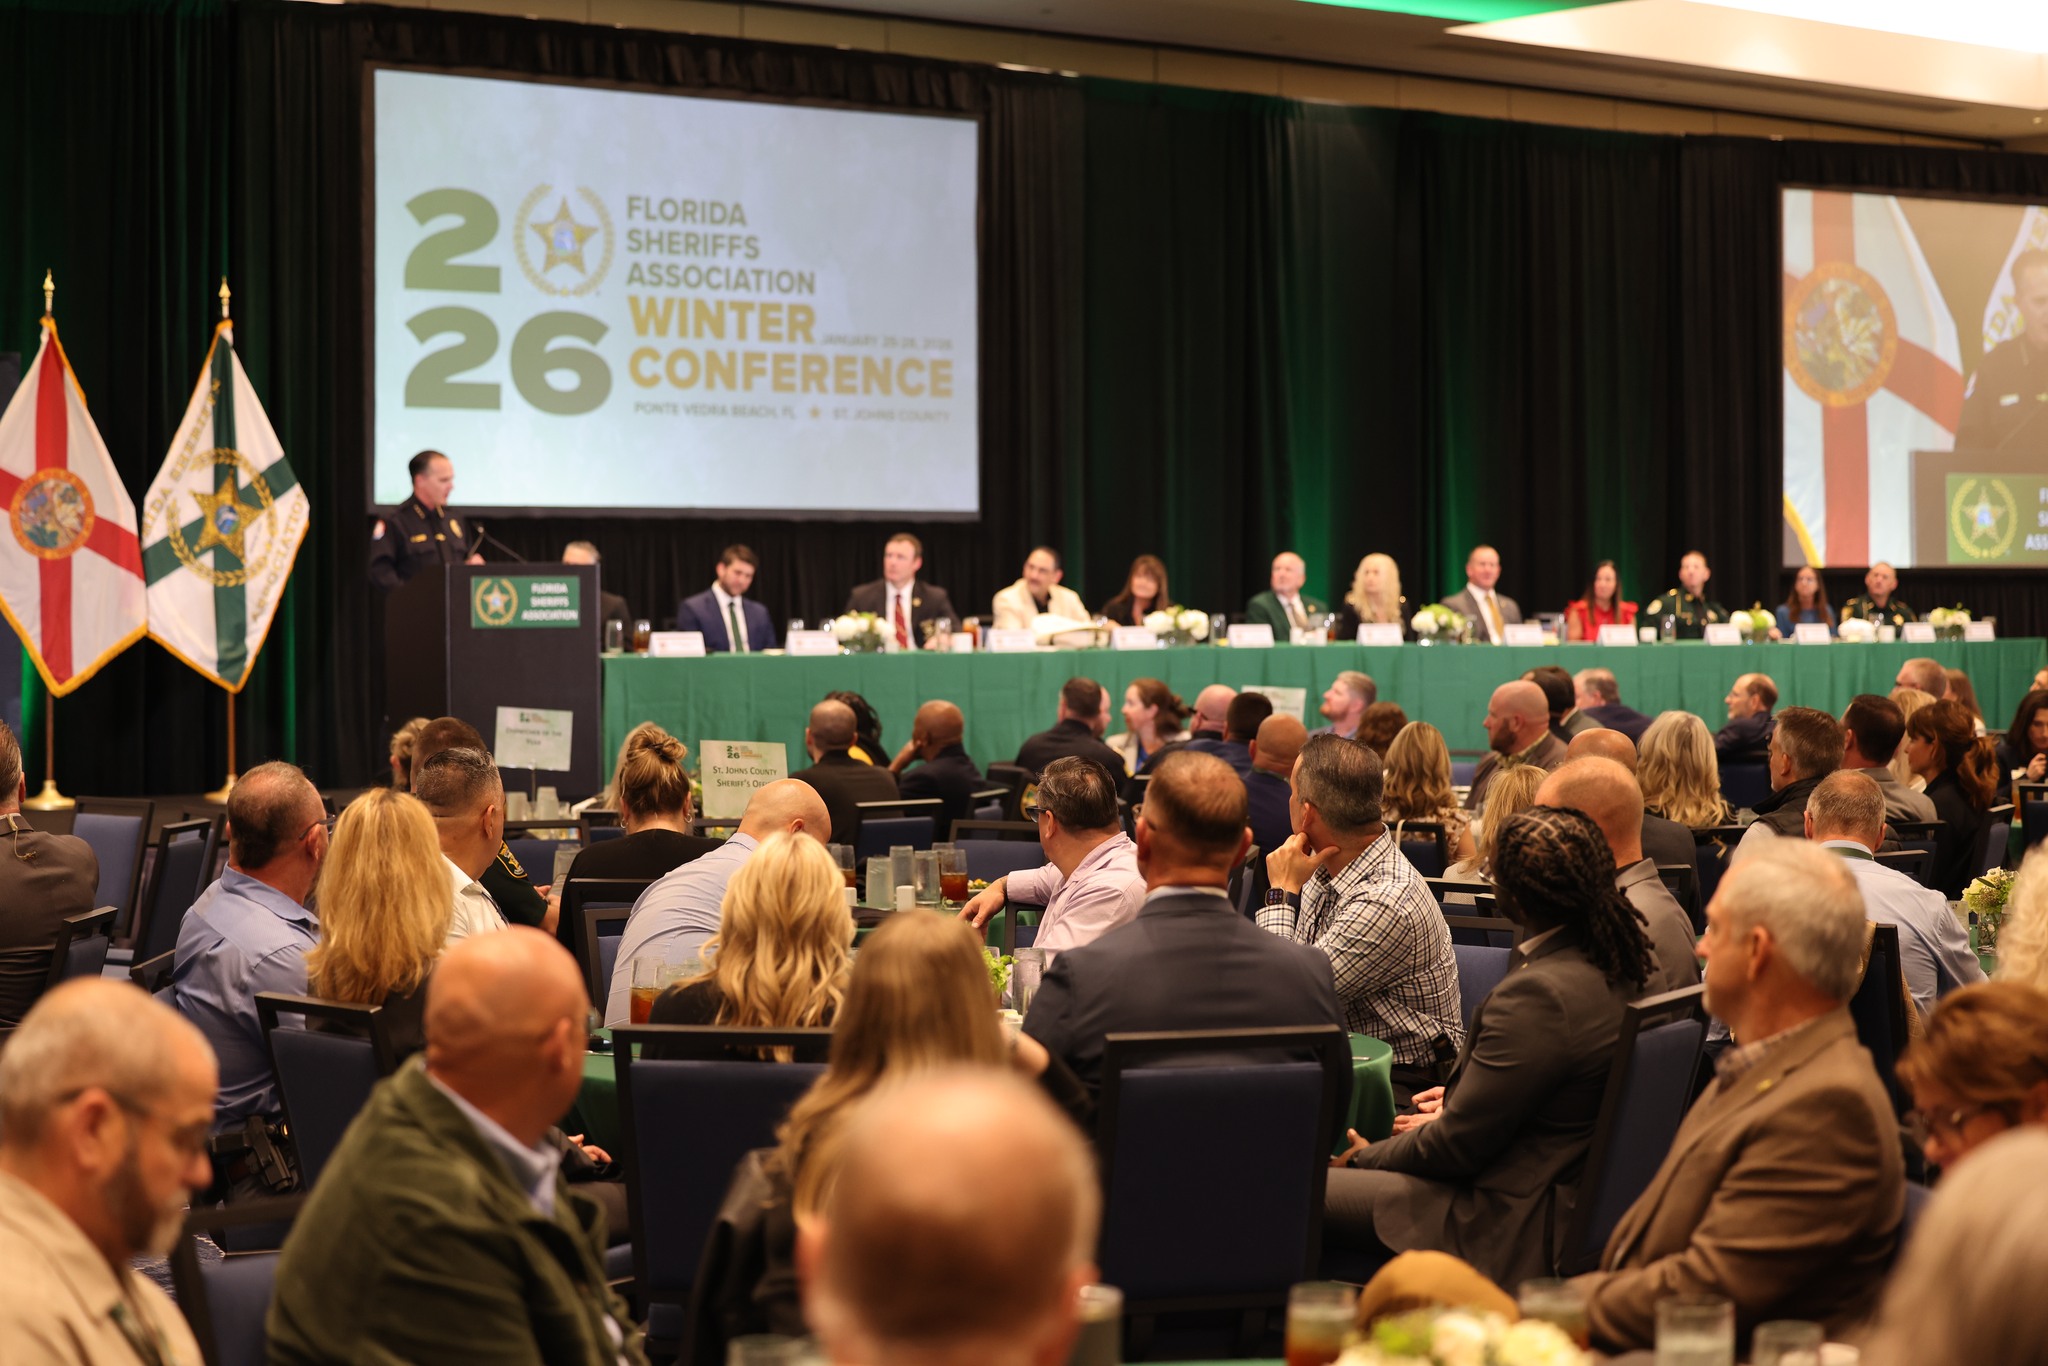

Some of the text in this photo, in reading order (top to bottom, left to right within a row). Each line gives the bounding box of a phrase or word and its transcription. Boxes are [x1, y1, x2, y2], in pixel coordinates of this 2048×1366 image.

[627, 195, 747, 227] FLORIDA
[404, 187, 501, 293] 2
[626, 229, 760, 260] SHERIFFS
[627, 262, 815, 295] ASSOCIATION
[627, 295, 816, 344] WINTER
[404, 305, 613, 416] 26
[628, 346, 954, 398] CONFERENCE
[634, 401, 679, 415] PONTE
[683, 402, 729, 417] VEDRA
[854, 408, 896, 421] JOHNS
[899, 408, 951, 423] COUNTY
[530, 582, 569, 594] FLORIDA
[530, 596, 570, 608] SHERIFFS
[521, 609, 579, 621] ASSOCIATION
